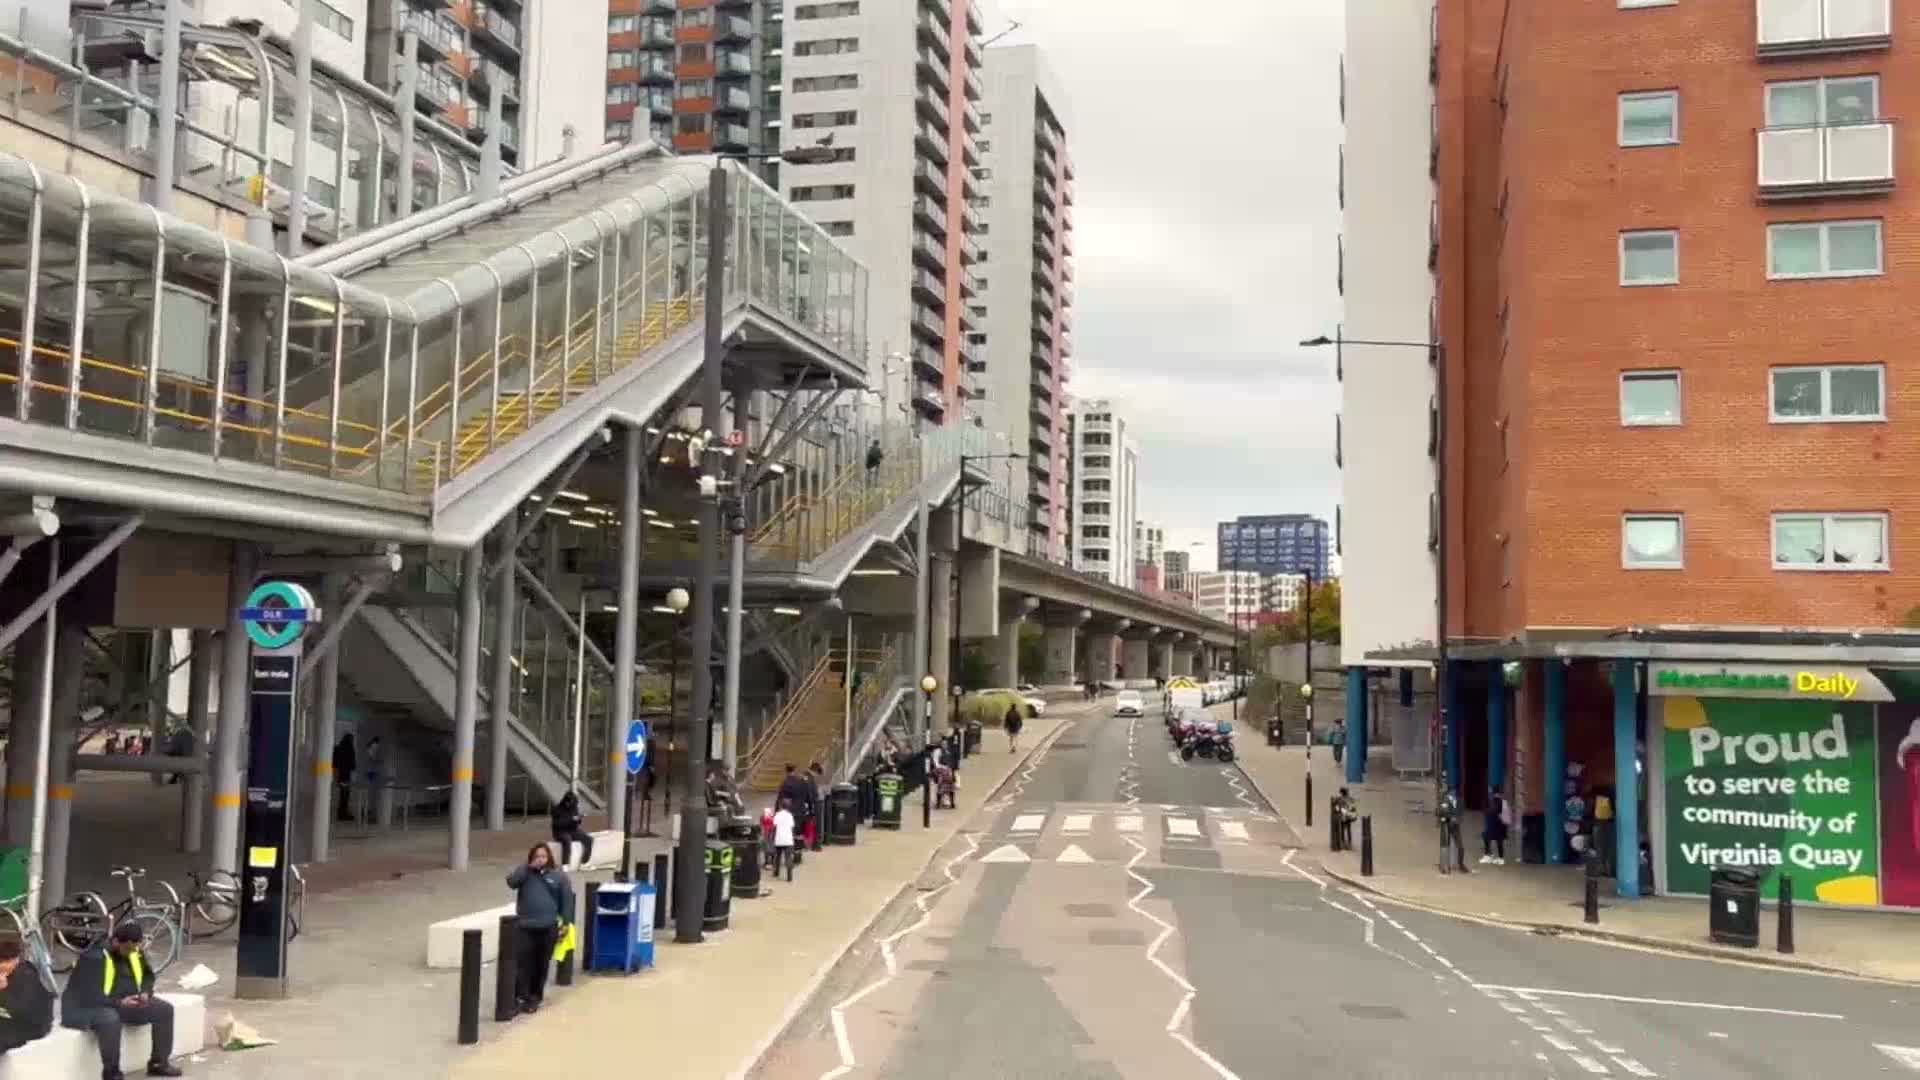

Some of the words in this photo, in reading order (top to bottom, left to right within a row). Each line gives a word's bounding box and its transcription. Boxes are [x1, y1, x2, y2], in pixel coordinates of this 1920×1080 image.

[1797, 671, 1857, 697] Daily
[1689, 713, 1849, 767] Proud
[1684, 774, 1717, 795] to
[1723, 777, 1796, 795] serve
[1802, 769, 1850, 794] the
[1682, 806, 1822, 836] community
[1827, 812, 1858, 833] of
[1788, 843, 1863, 872] Quay
